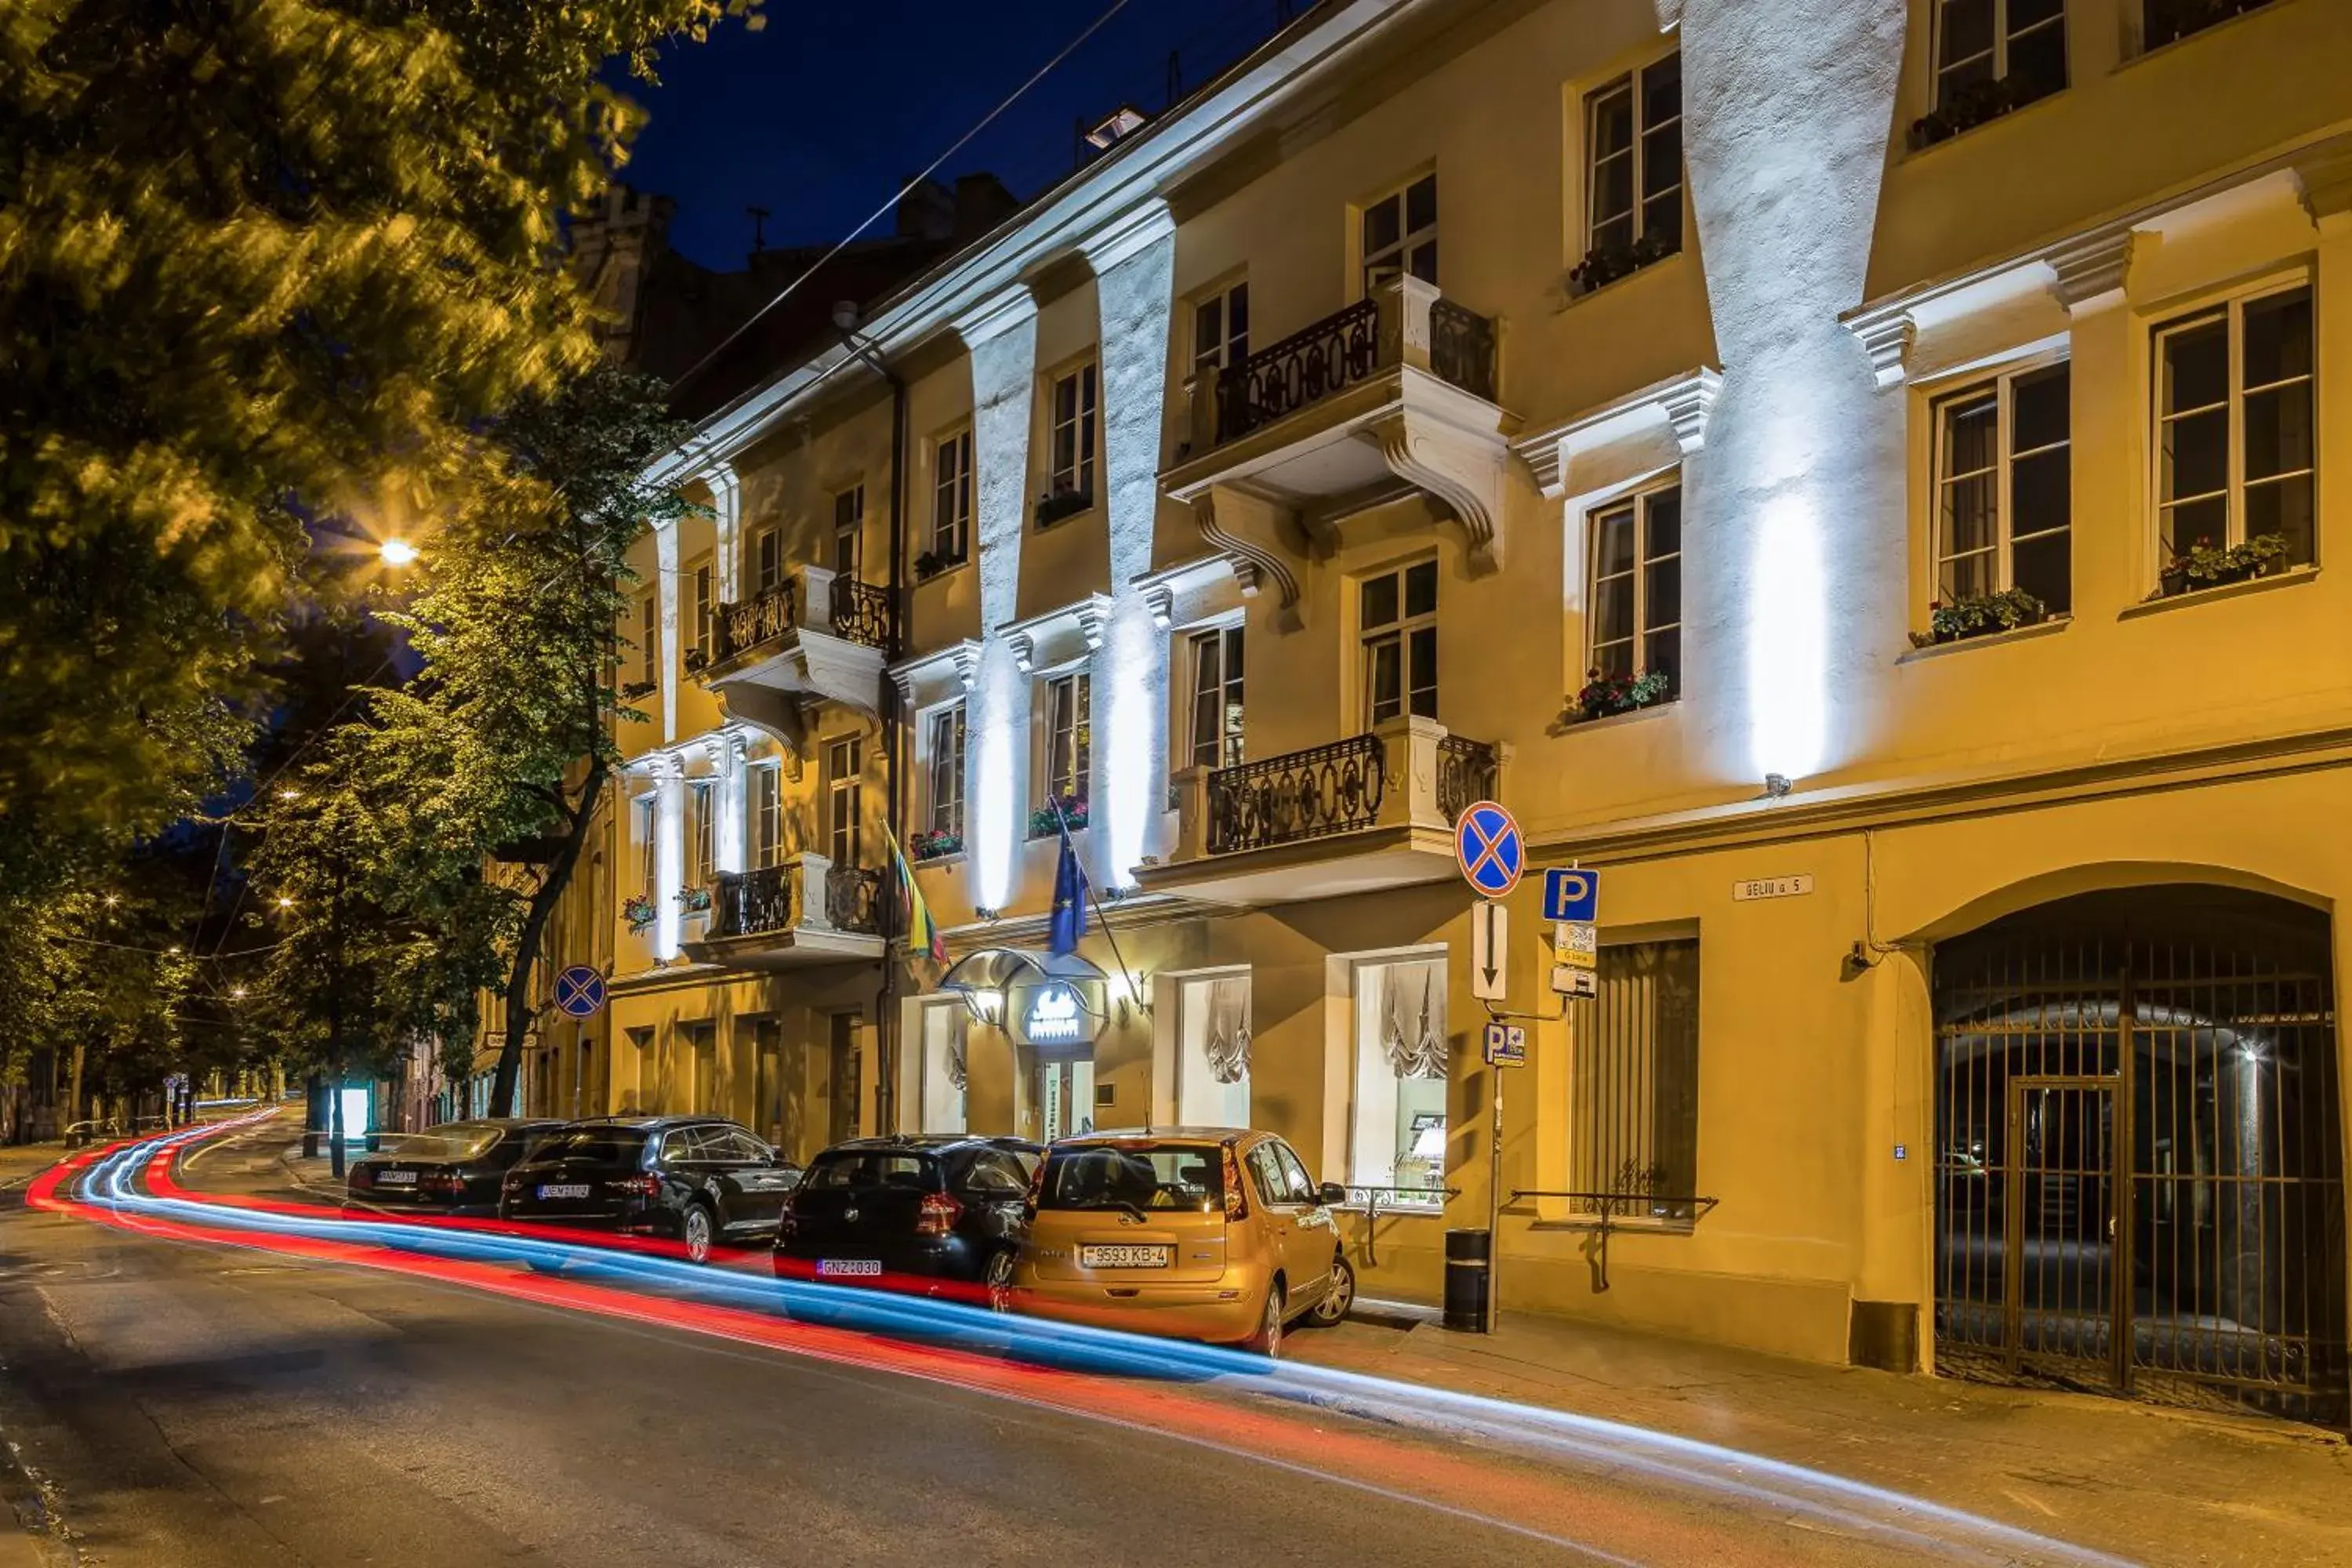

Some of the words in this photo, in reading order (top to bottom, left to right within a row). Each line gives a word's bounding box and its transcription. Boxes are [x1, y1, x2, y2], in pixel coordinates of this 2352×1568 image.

[1557, 874, 1589, 916] P
[1487, 1025, 1505, 1062] P
[1096, 1247, 1127, 1261] 9593
